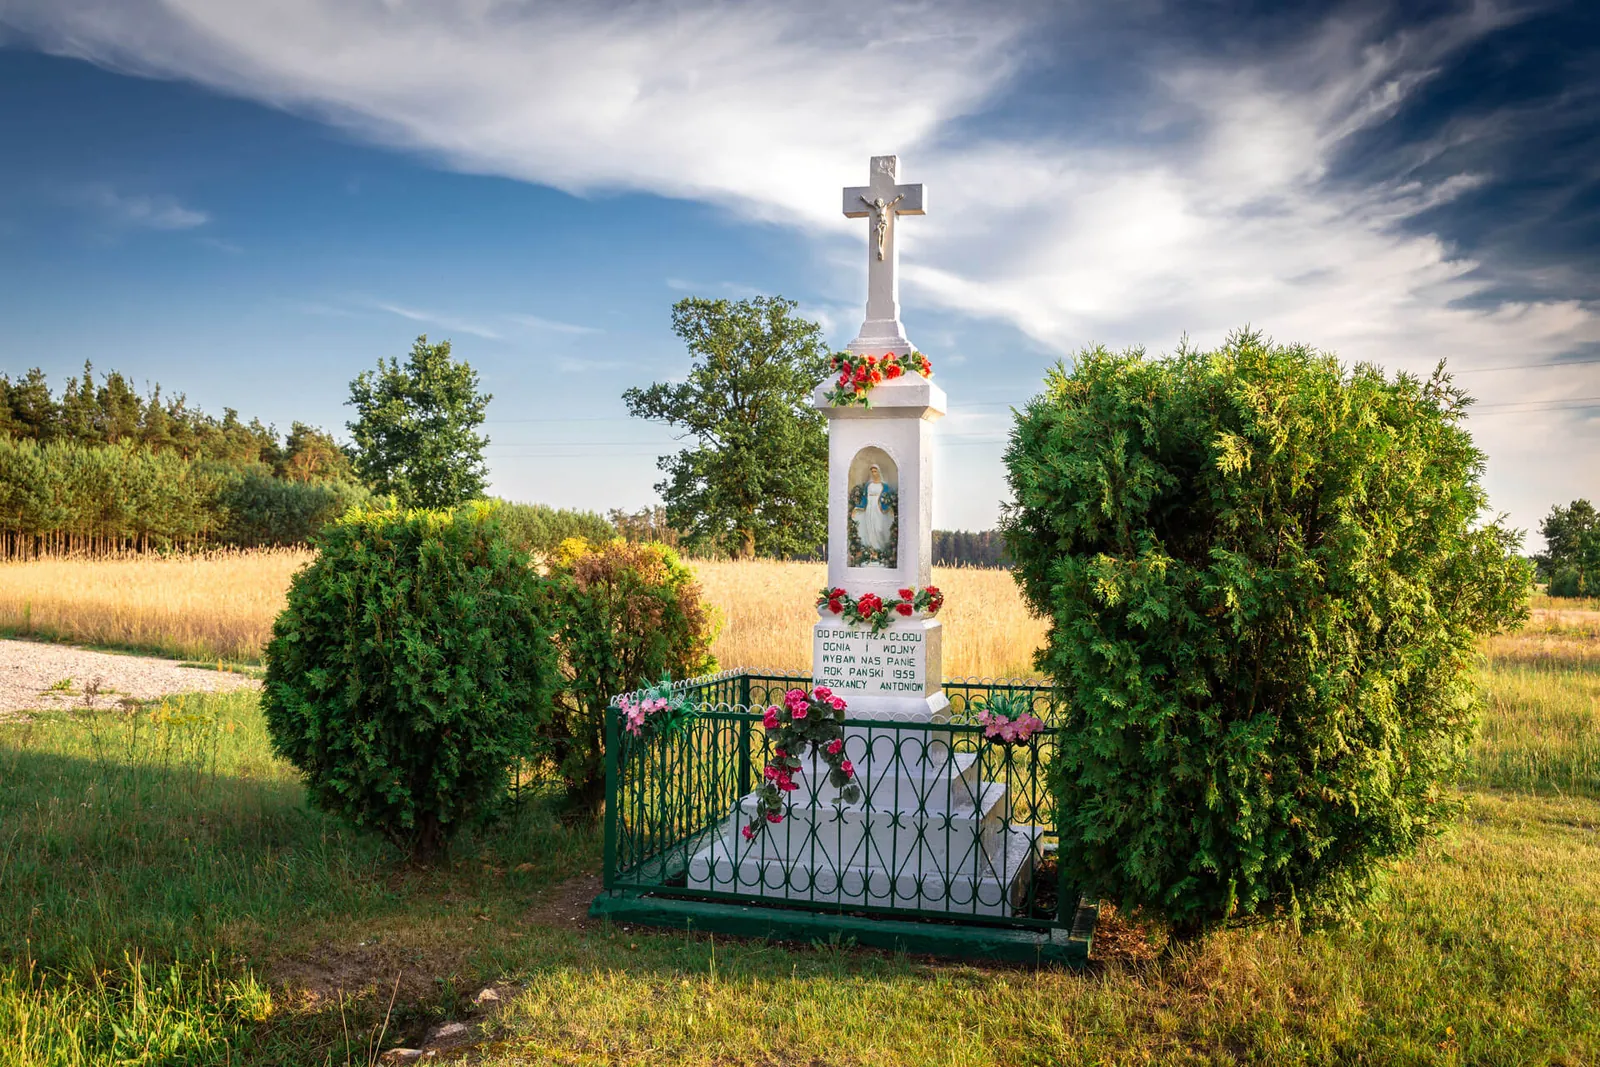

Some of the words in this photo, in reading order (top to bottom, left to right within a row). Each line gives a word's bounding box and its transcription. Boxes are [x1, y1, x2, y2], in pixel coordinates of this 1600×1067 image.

[817, 629, 830, 639] OD
[832, 630, 886, 640] POWIETRZA
[823, 642, 851, 652] OGNIA
[883, 645, 916, 655] WOJNY
[822, 654, 856, 664] WYBAW
[861, 656, 881, 666] NAS
[886, 657, 916, 667] PANIE
[823, 666, 843, 676] ROK
[892, 669, 916, 679] 1959
